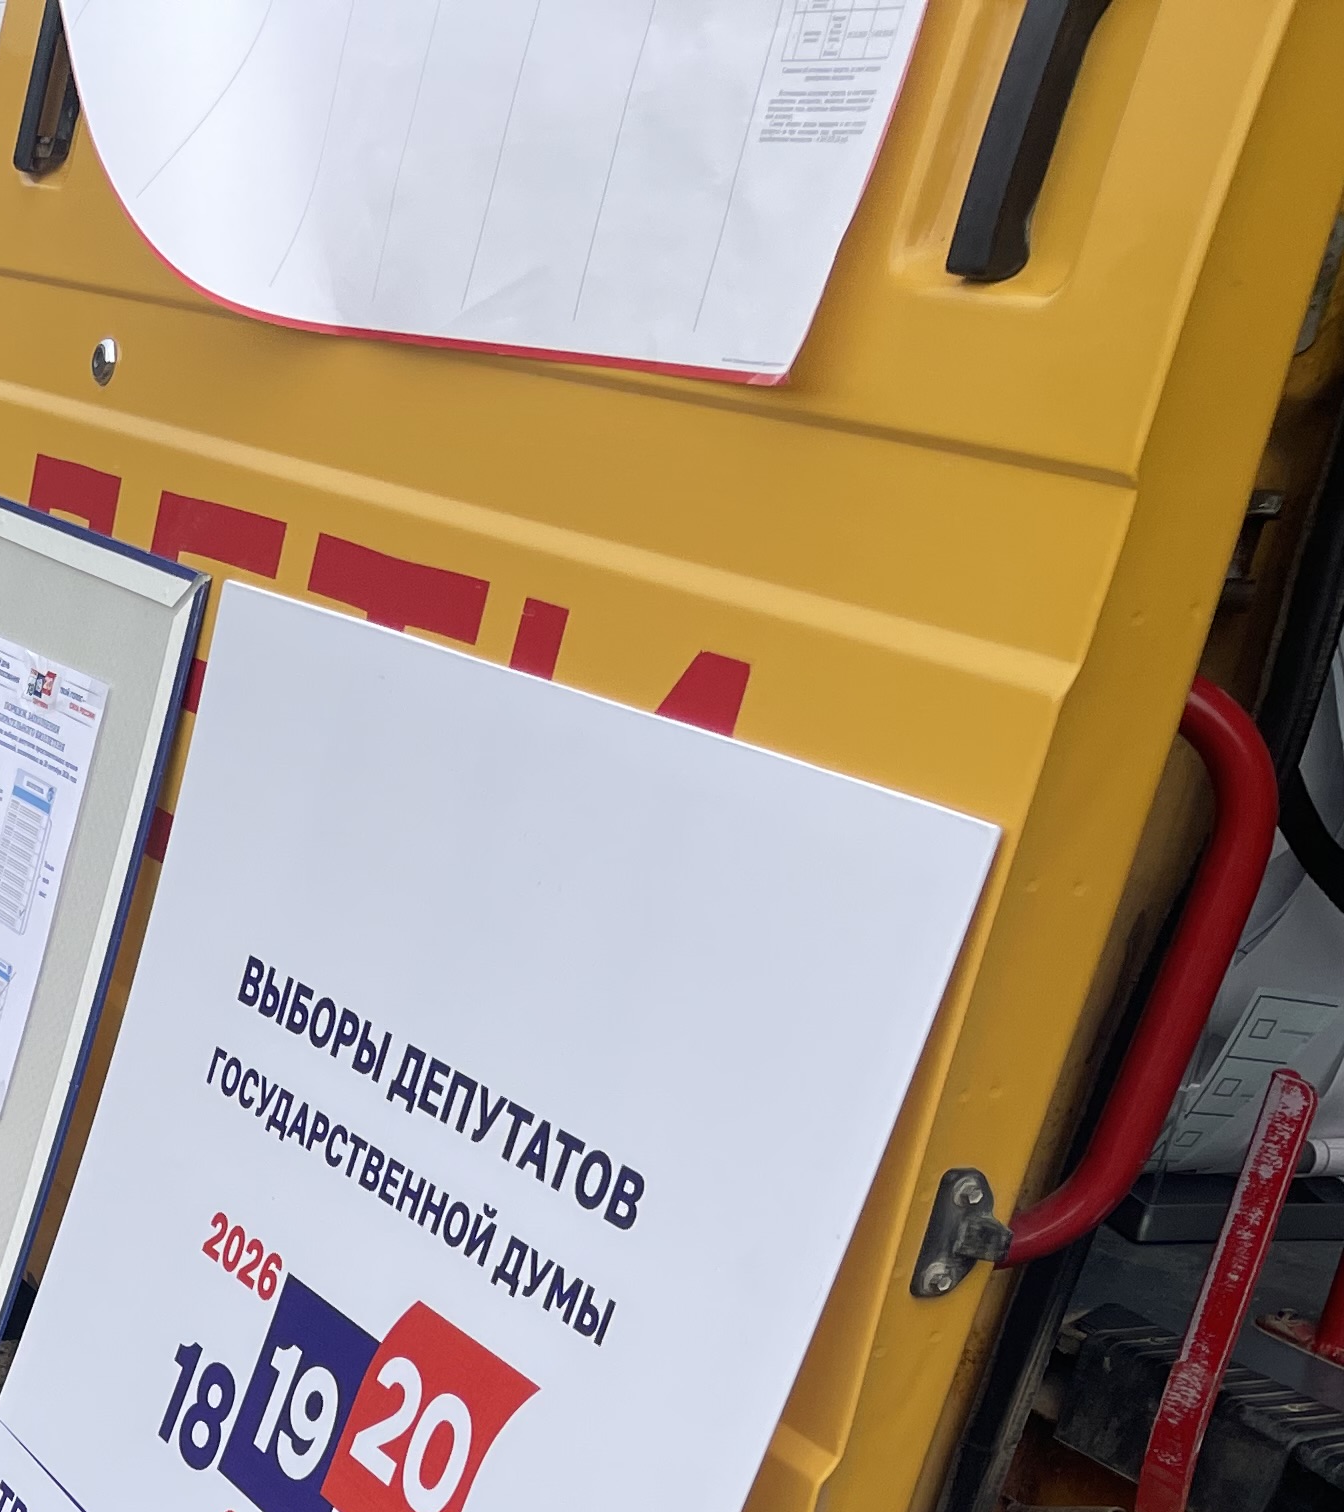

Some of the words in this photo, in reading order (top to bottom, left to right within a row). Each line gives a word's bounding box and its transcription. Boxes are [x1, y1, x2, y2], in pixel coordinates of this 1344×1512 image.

[238, 956, 392, 1083] ВЫБОРЫ
[387, 1044, 644, 1230] ДЕПУТАТОВ
[203, 1213, 283, 1300] 2026
[207, 1047, 497, 1267] ГОСУДАРСТВЕННОЙ
[491, 1236, 616, 1346] ДУМЫ
[159, 1342, 235, 1470] 18
[254, 1345, 338, 1479] 19
